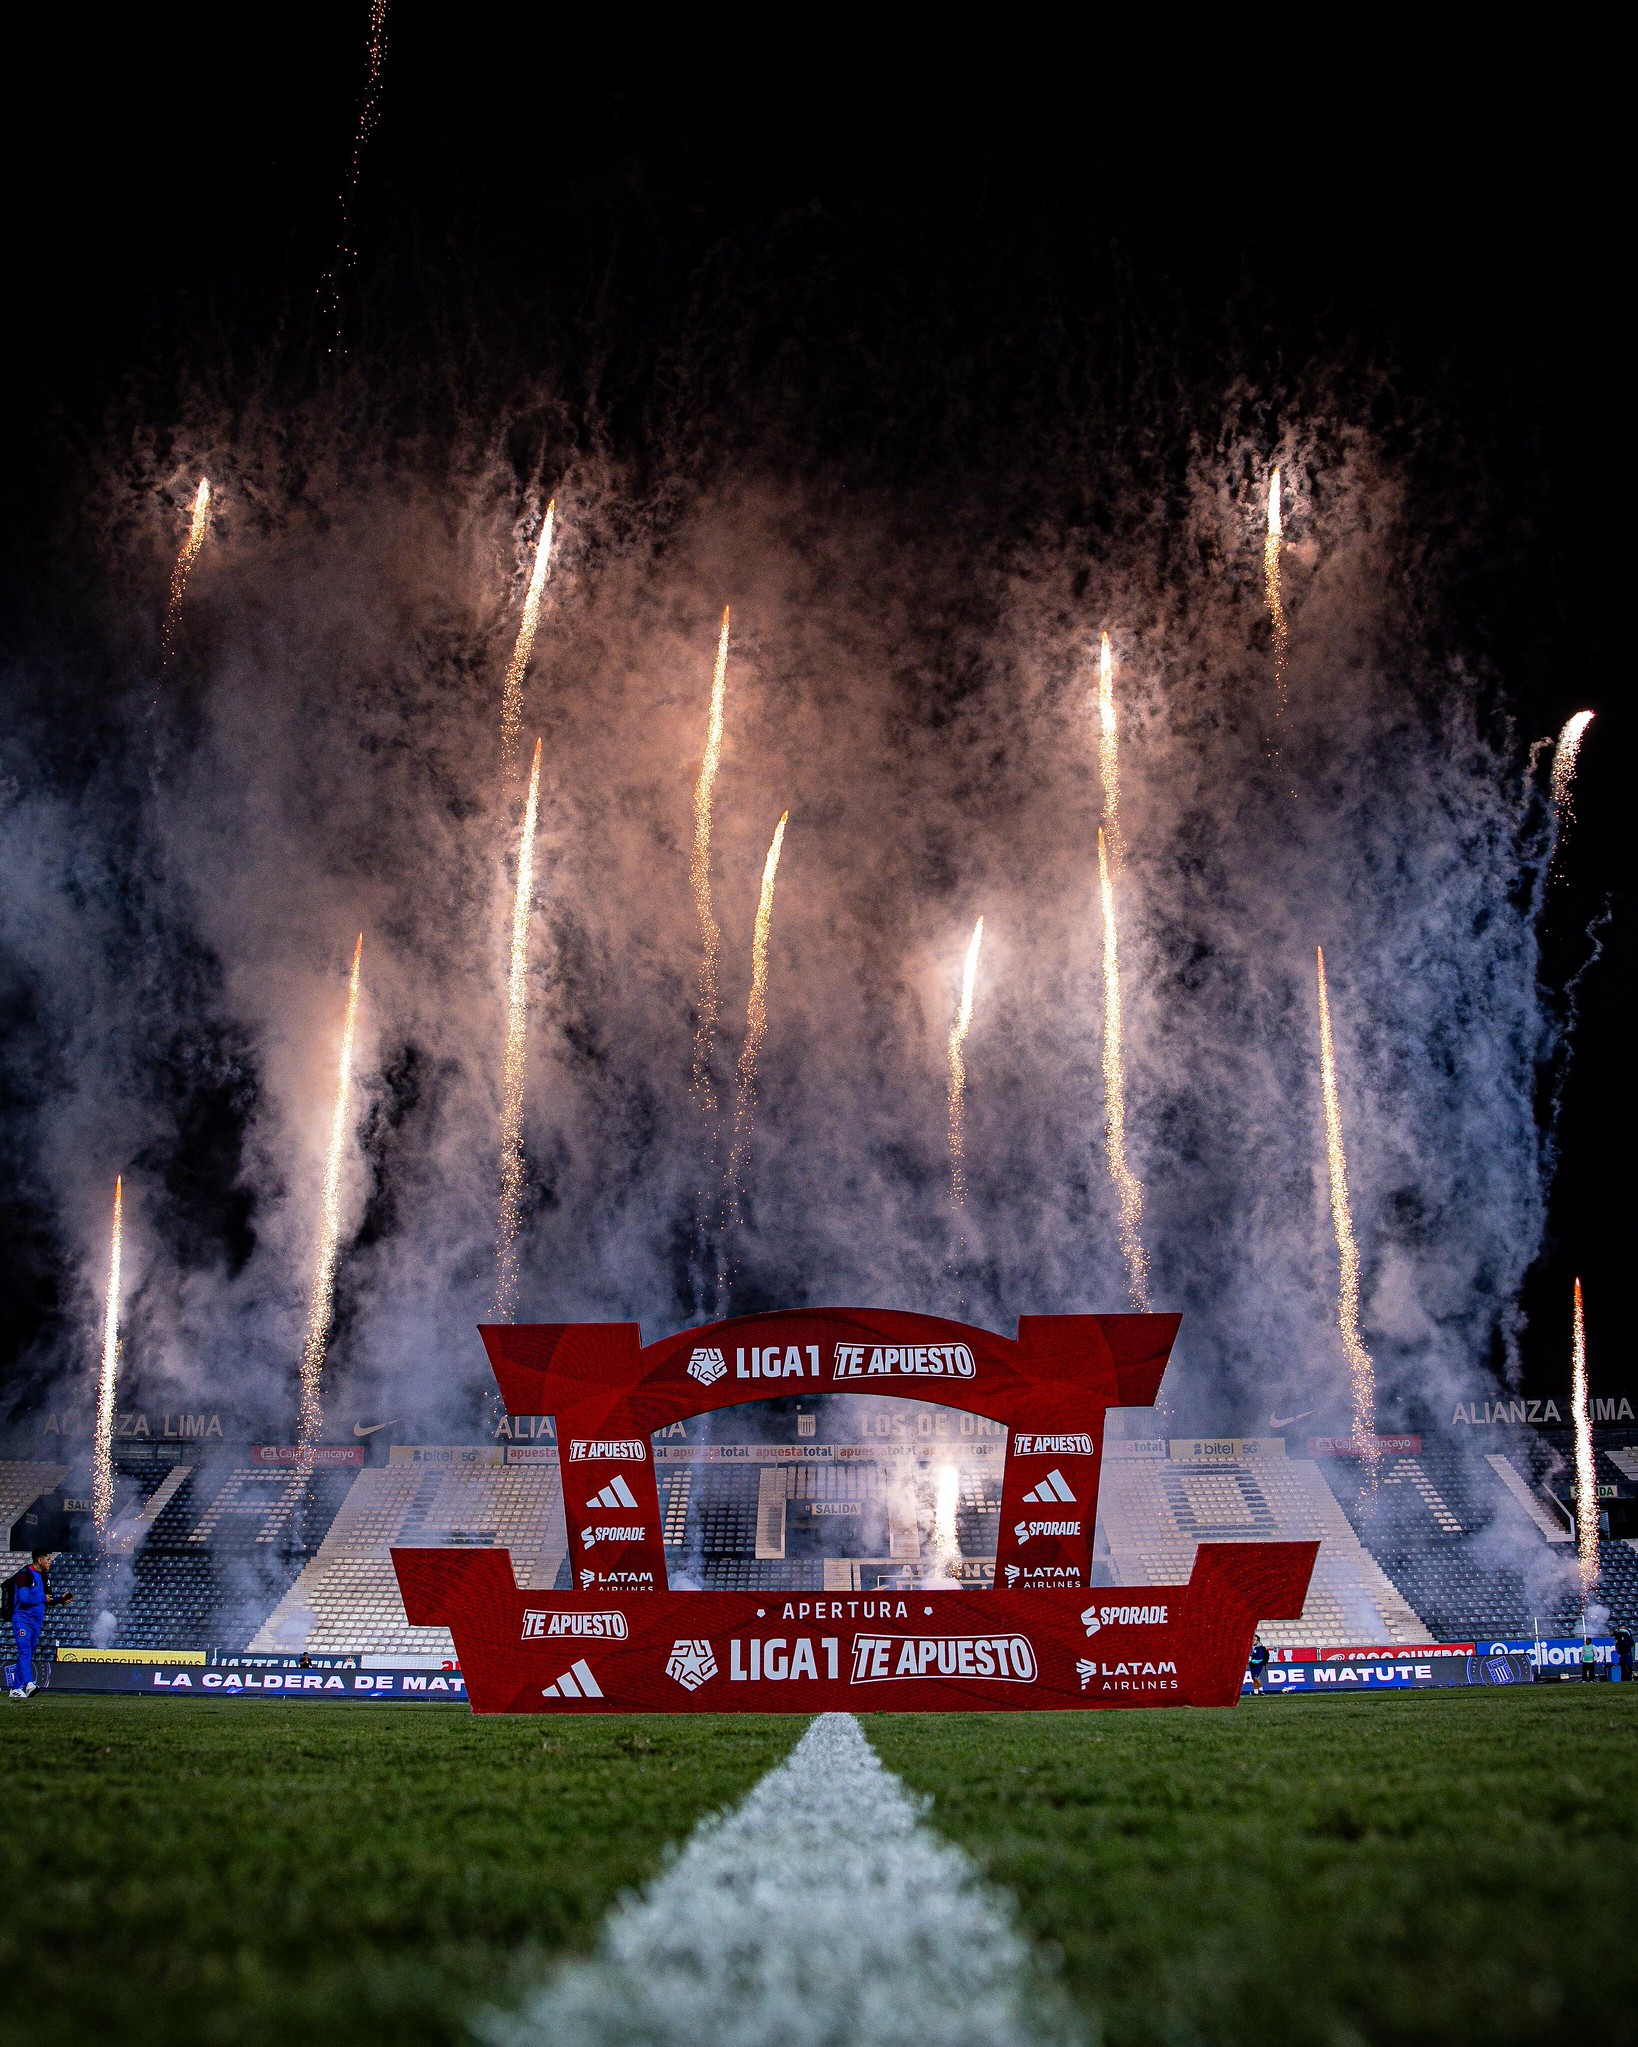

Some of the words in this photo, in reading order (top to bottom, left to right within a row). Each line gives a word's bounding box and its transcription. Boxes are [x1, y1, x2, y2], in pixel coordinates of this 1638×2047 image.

[736, 1345, 820, 1379] LIGA1
[837, 1346, 864, 1377] TE
[870, 1346, 971, 1377] APUESTO
[1452, 1399, 1562, 1425] ALIANZA
[1588, 1398, 1635, 1421] IMA
[42, 1413, 151, 1436] ALZA
[163, 1414, 224, 1437] LIMA
[494, 1415, 553, 1439] ALIA
[861, 1412, 906, 1437] LOS
[917, 1412, 949, 1437] DE
[572, 1442, 587, 1459] TE
[588, 1442, 644, 1460] APUESTO
[756, 1446, 832, 1459] apuestatotal
[840, 1446, 917, 1459] apuestotal
[1017, 1436, 1032, 1453] TE
[1033, 1436, 1091, 1454] APUESTO
[1202, 1442, 1234, 1454] bitel
[1242, 1443, 1258, 1454] 5G
[1335, 1439, 1358, 1452] Caja
[1362, 1438, 1411, 1451] ancayo
[280, 1448, 303, 1461] Caja
[305, 1448, 354, 1461] ancayo
[423, 1450, 453, 1461] bitel
[462, 1451, 477, 1461] 5G
[1574, 1486, 1614, 1497] SIDA
[815, 1503, 858, 1514] SALIDA
[595, 1526, 645, 1541] SPORADE
[1029, 1521, 1081, 1536] SPORADE
[598, 1572, 654, 1583] LATAM
[1023, 1566, 1081, 1577] LATAM
[1024, 1580, 1081, 1588] AIRLINES
[782, 1601, 908, 1619] APERTURA
[1100, 1606, 1168, 1625] SPORADE
[525, 1613, 546, 1636] TE
[547, 1613, 625, 1637] APUESTO
[730, 1637, 839, 1681] LIGA1
[856, 1639, 891, 1679] TE
[895, 1638, 1033, 1678] APUESTO
[1101, 1661, 1177, 1676] LATAM
[1267, 1668, 1306, 1684] DE
[1313, 1664, 1432, 1683] MATUTE
[153, 1671, 192, 1688] LA
[202, 1672, 345, 1690] CALDERA
[354, 1674, 394, 1689] DE
[1102, 1680, 1178, 1690] AIRLINES
